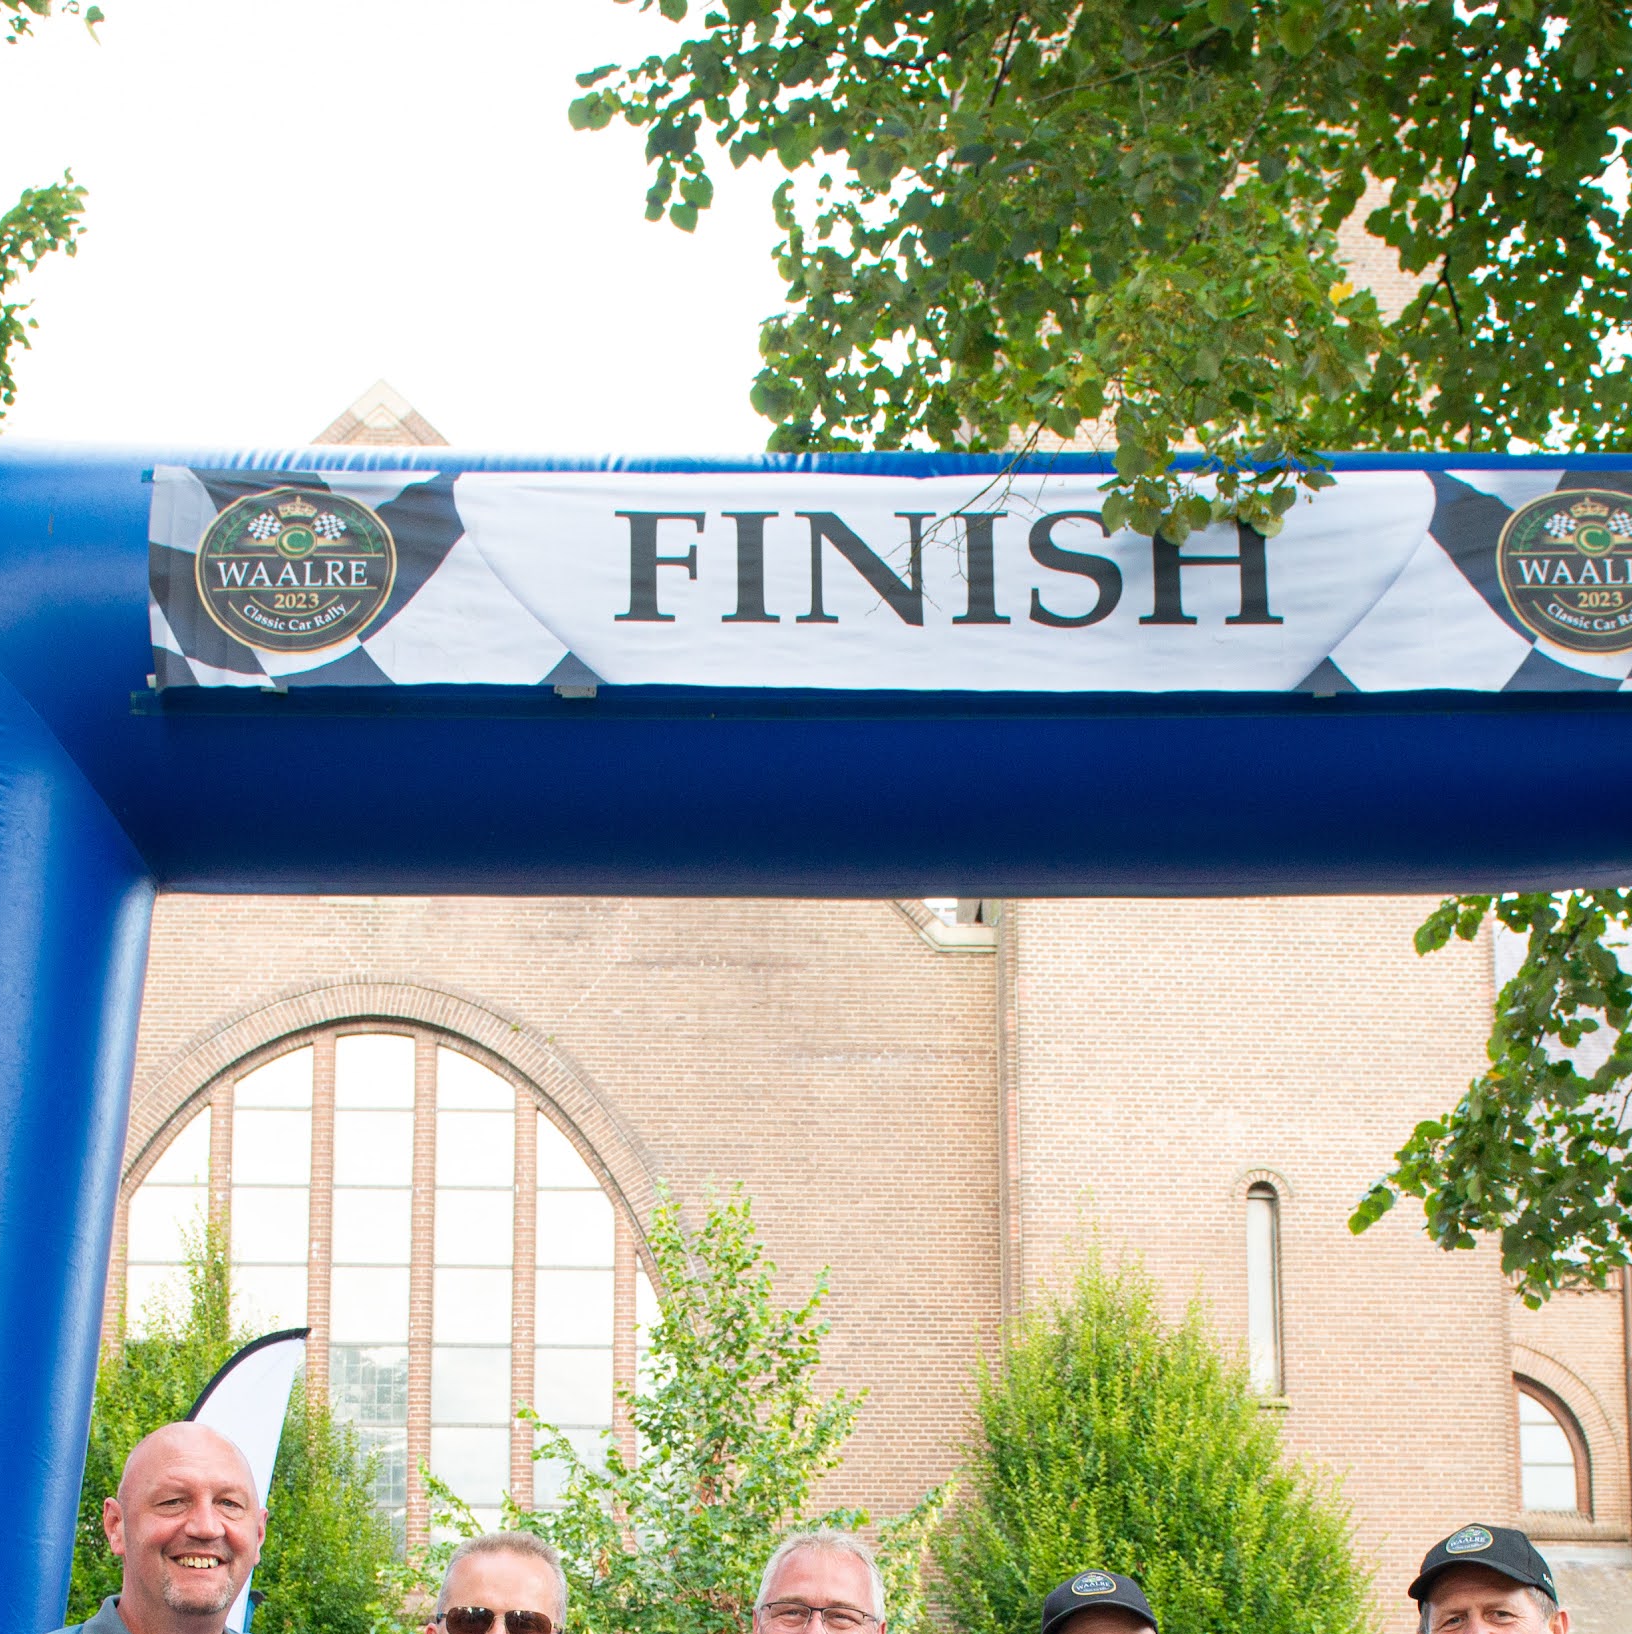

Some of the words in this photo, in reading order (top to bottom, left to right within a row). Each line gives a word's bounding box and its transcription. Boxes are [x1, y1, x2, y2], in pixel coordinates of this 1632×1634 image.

[217, 560, 368, 587] WAALRE
[614, 510, 1285, 629] FINISH
[274, 592, 319, 609] 2023
[1577, 591, 1624, 608] 2023
[243, 603, 285, 631] Classic
[288, 618, 312, 632] Car
[314, 602, 347, 627] Rally
[1546, 602, 1590, 630] Classic
[1592, 618, 1617, 632] Car
[1076, 1581, 1110, 1591] WAALRE
